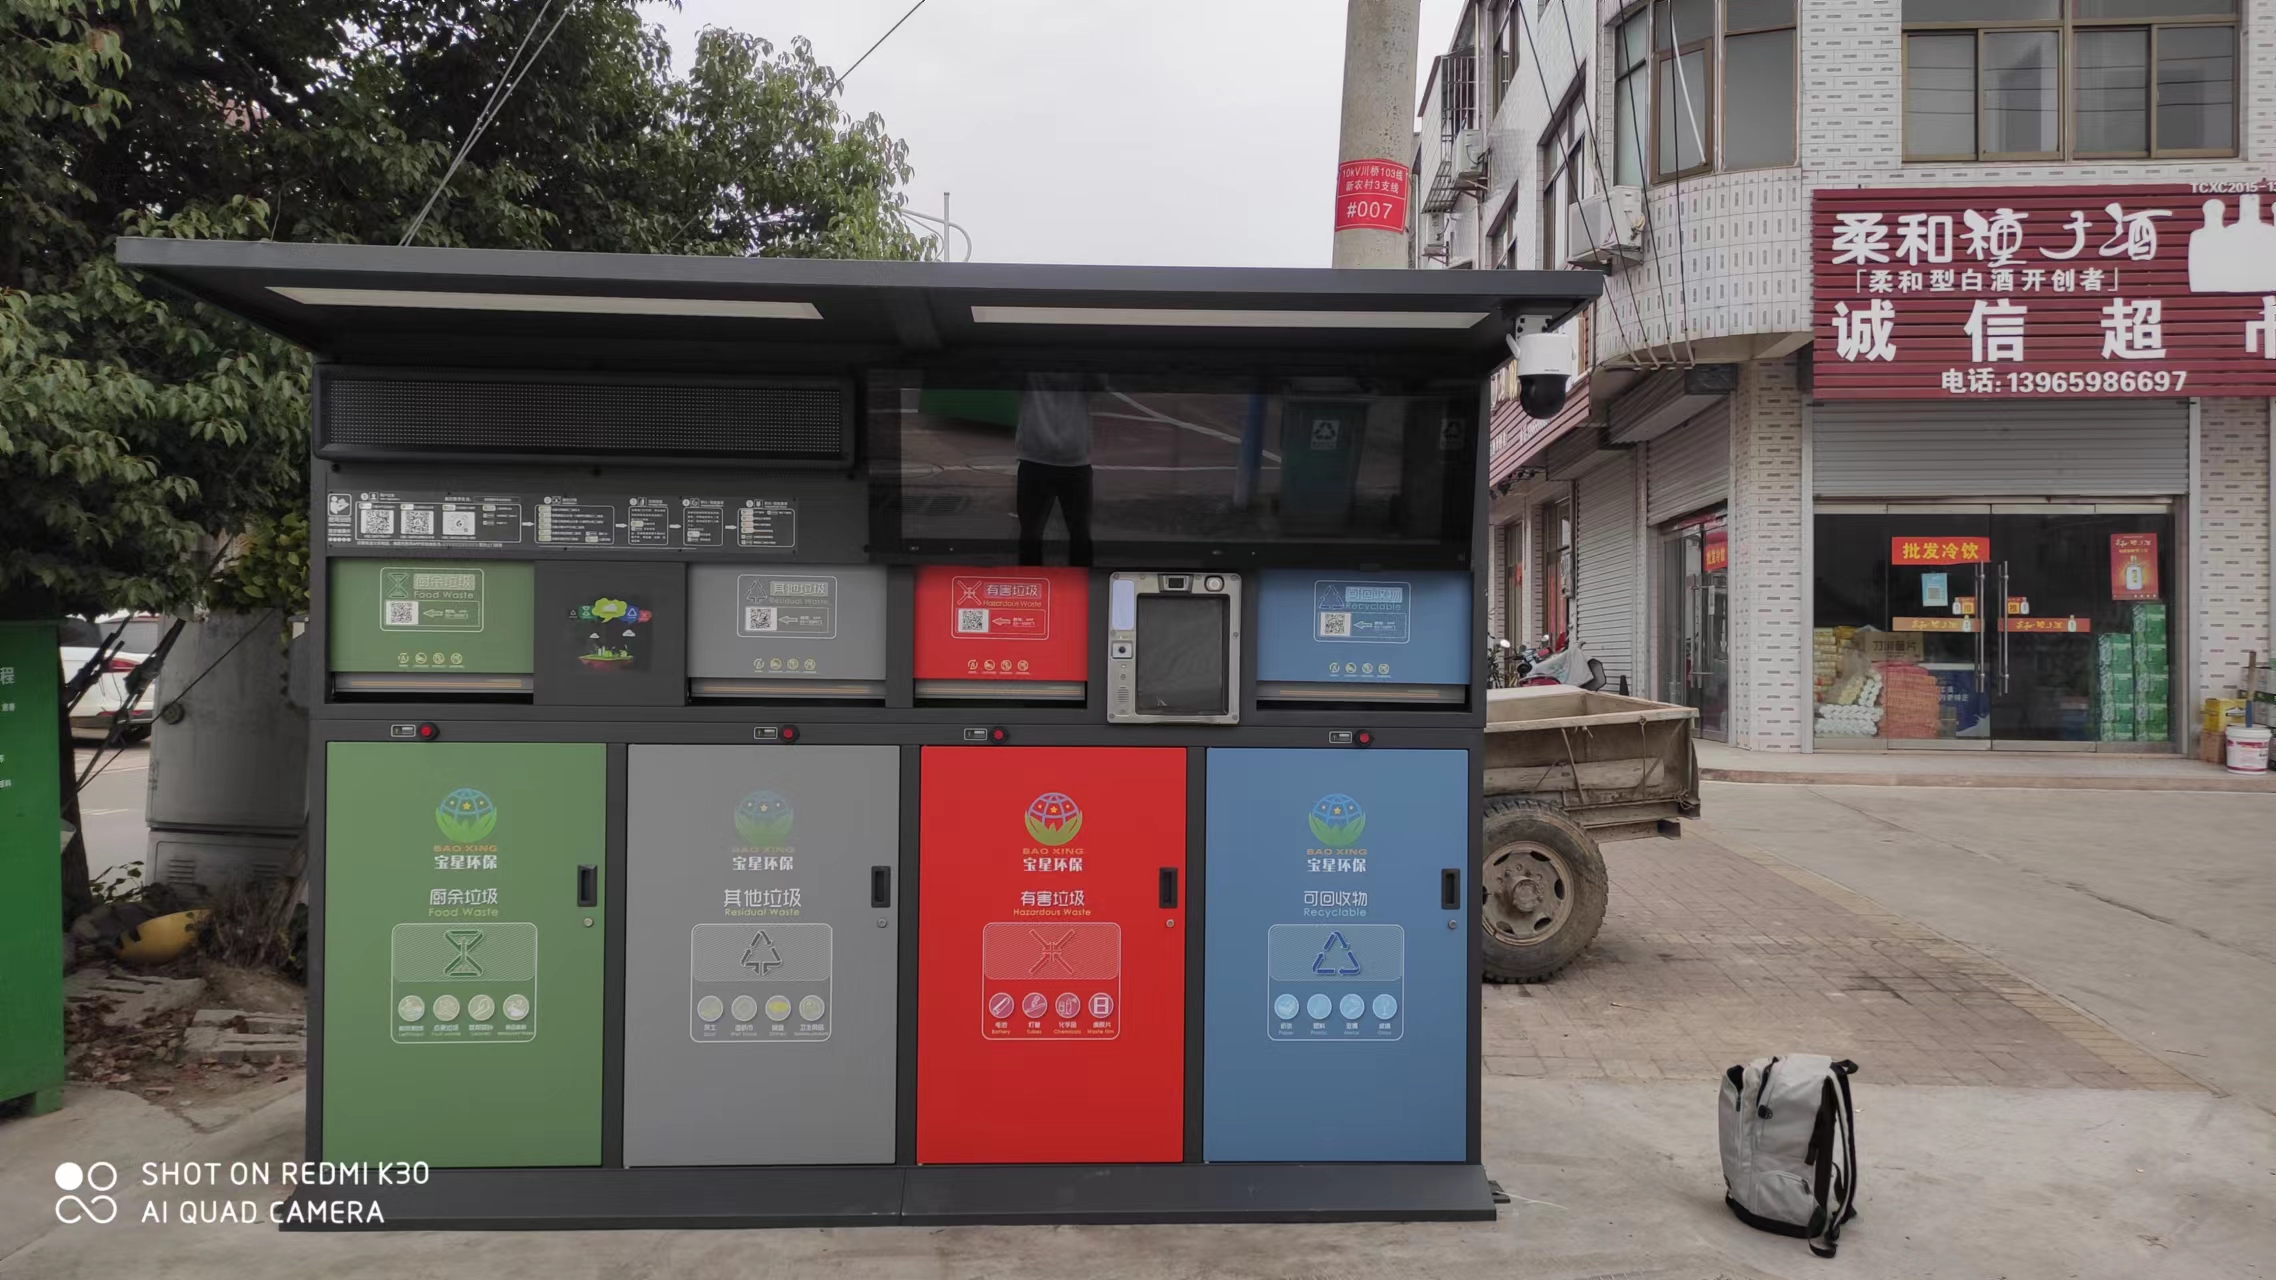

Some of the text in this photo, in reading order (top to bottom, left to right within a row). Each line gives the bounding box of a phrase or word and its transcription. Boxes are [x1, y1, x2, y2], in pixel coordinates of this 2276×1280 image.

[1346, 200, 1393, 220] #007
[1902, 542, 1980, 560] 批发冷饮
[413, 591, 474, 599] Food Waste
[986, 584, 1039, 597] 有害垃圾
[1306, 848, 1368, 856] BAO XING
[434, 855, 498, 870] 宝星环保
[732, 856, 794, 871] 宝星环保
[1023, 857, 1083, 872] 宝星环保
[1307, 858, 1367, 873] 宝星环保
[429, 888, 498, 905] 厨余垃圾
[723, 888, 802, 907] 其他垃圾
[1021, 890, 1085, 907] 有害垃圾
[1304, 890, 1368, 907] 可回收物
[428, 908, 499, 917] Food Waste
[725, 908, 800, 917] Residual Waste
[1013, 908, 1091, 916] Hazardous Waste
[1304, 907, 1367, 918] Recyclable
